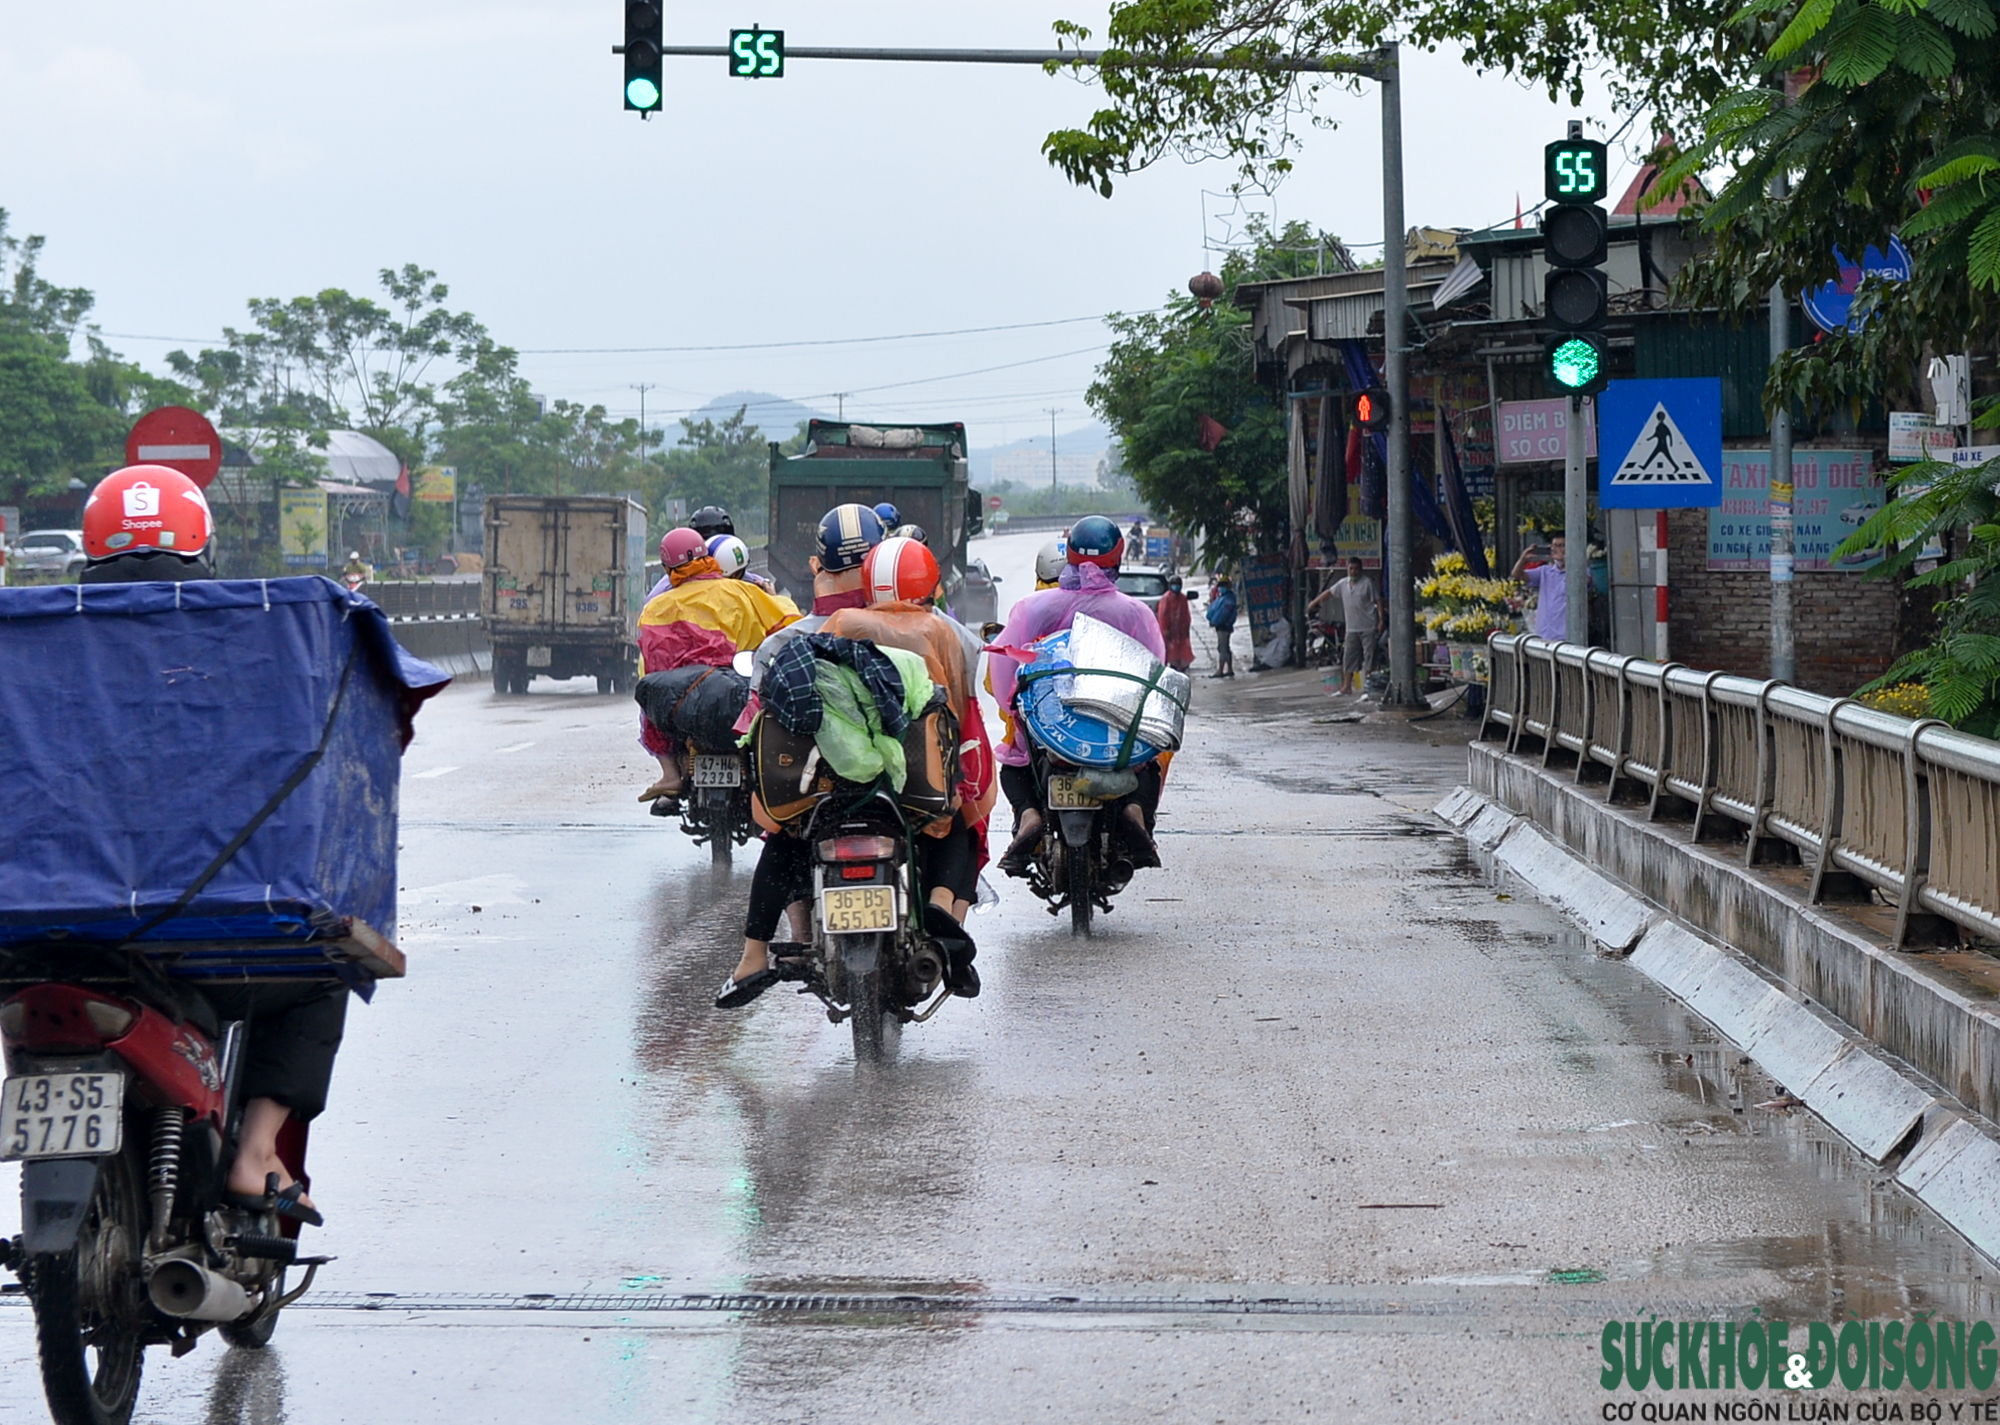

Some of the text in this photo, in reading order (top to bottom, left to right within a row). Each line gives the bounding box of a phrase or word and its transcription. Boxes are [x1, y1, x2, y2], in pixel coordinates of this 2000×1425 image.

[733, 33, 779, 74] 55
[1556, 151, 1595, 192] 55
[1971, 451, 1983, 461] XE
[121, 519, 163, 531] Shopee
[1738, 525, 1752, 536] XE
[701, 771, 734, 785] 2329
[833, 889, 884, 909] 36-B5
[828, 909, 891, 931] 455.15
[17, 1076, 104, 1114] 43-S5
[14, 1114, 101, 1152] 5776
